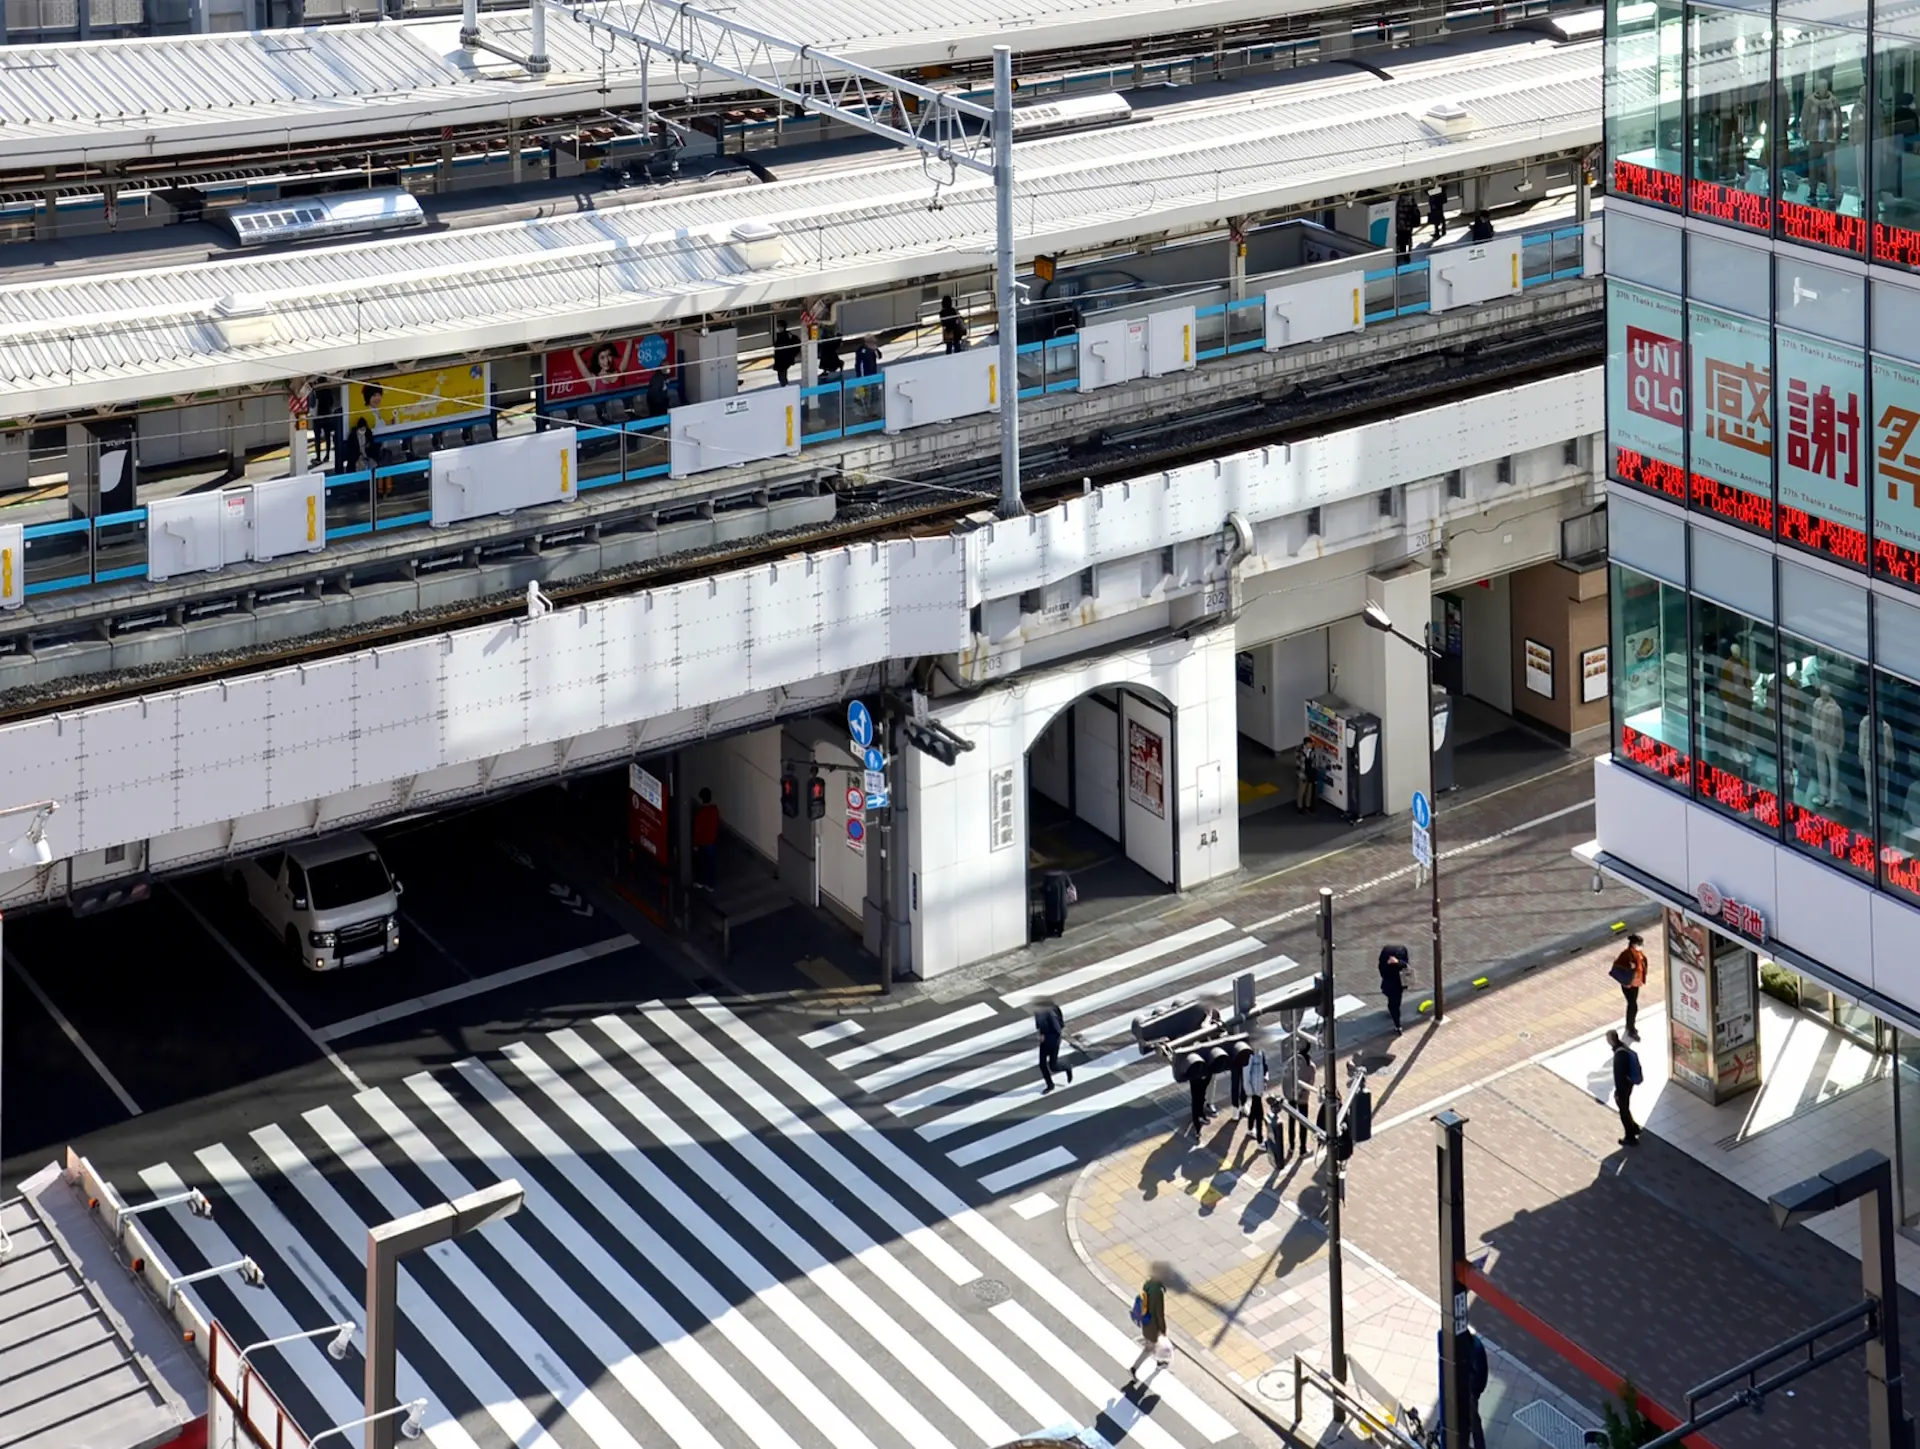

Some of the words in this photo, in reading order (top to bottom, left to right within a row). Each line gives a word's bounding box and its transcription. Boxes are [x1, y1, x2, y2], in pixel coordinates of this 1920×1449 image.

[1634, 338, 1681, 378] UNI
[1634, 375, 1684, 416] QLO
[1207, 591, 1224, 607] 202
[982, 656, 1002, 673] 203
[1722, 897, 1765, 941] 吉池
